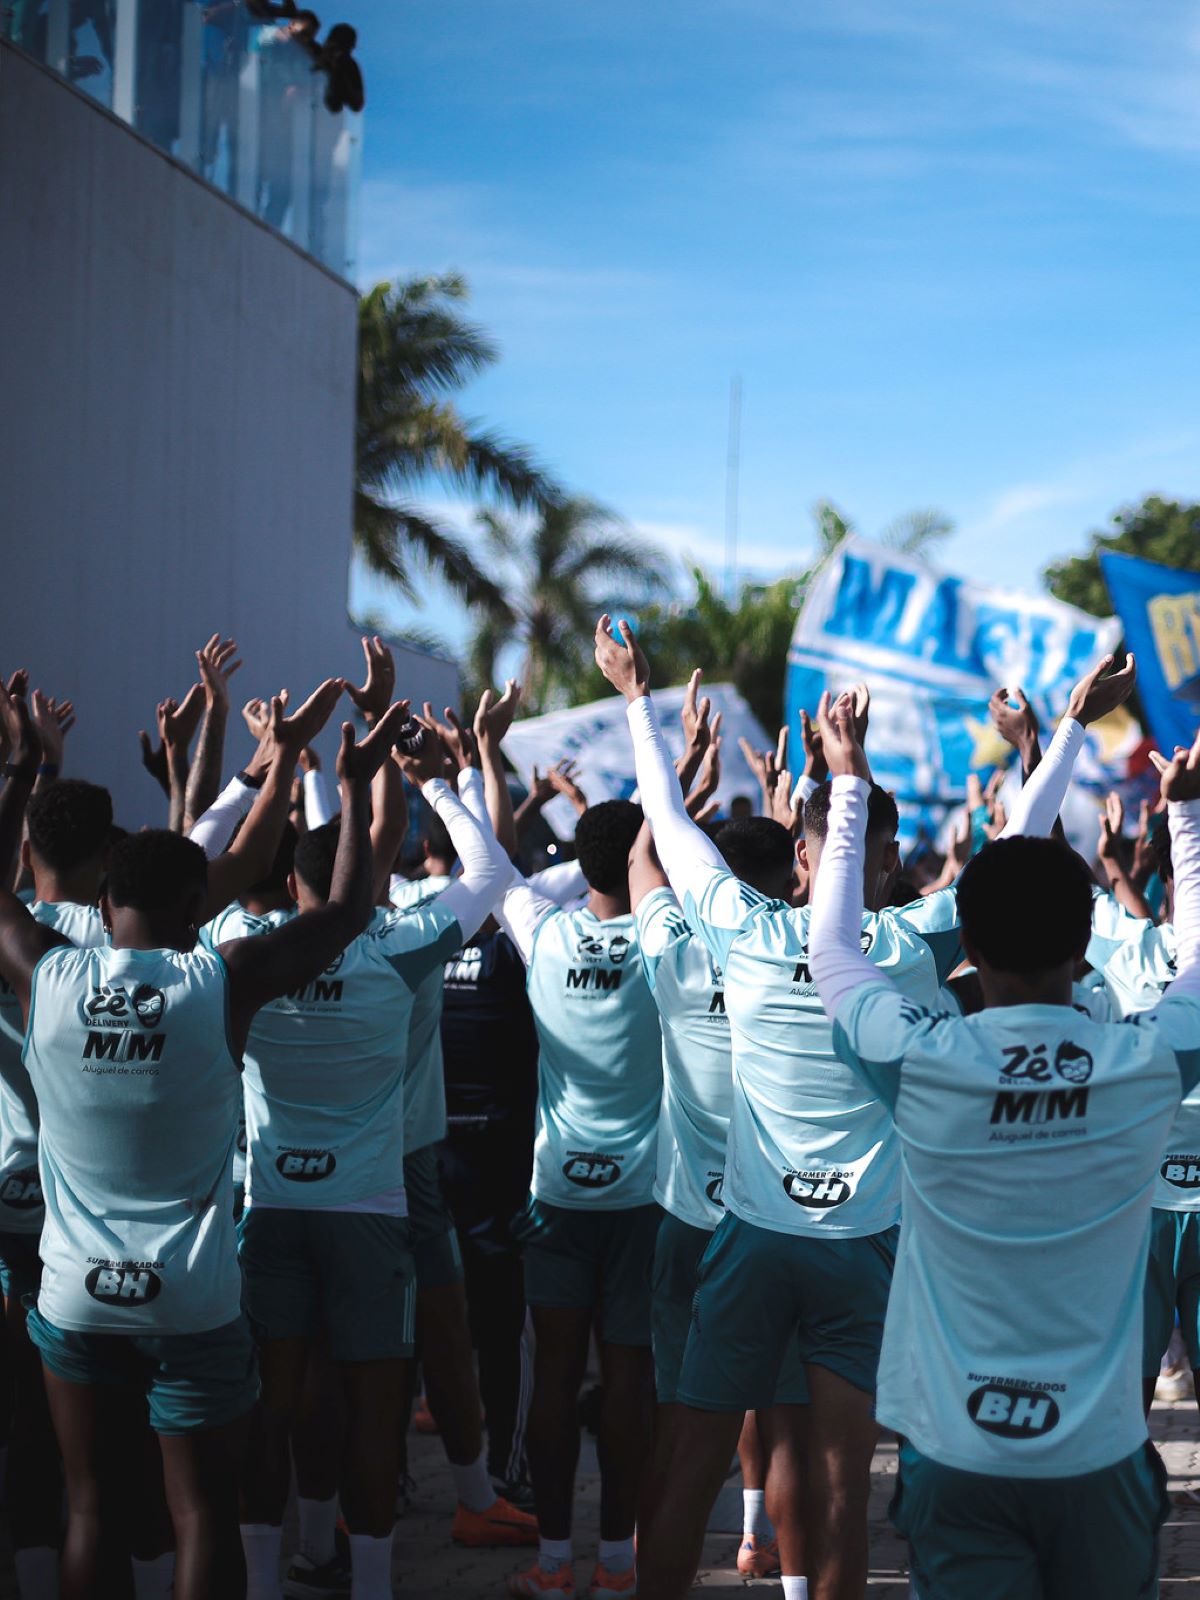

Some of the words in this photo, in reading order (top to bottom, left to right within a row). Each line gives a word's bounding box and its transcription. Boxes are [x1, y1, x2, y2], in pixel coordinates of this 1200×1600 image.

[85, 1018, 130, 1028] DELIVERY
[82, 1030, 167, 1062] MM
[82, 1063, 117, 1076] Aluguel
[117, 1066, 130, 1075] de
[131, 1068, 161, 1076] carros
[1000, 1043, 1053, 1083] Zé
[989, 1086, 1090, 1125] MM
[989, 1130, 1033, 1143] Aluguel
[1035, 1130, 1050, 1140] de
[1051, 1127, 1088, 1138] carros
[282, 1154, 329, 1174] BH
[568, 1161, 615, 1181] BH
[790, 1177, 845, 1201] BH
[94, 1269, 150, 1299] BH
[967, 1372, 1067, 1393] SUPERMERCADOS
[976, 1390, 1052, 1430] BH
